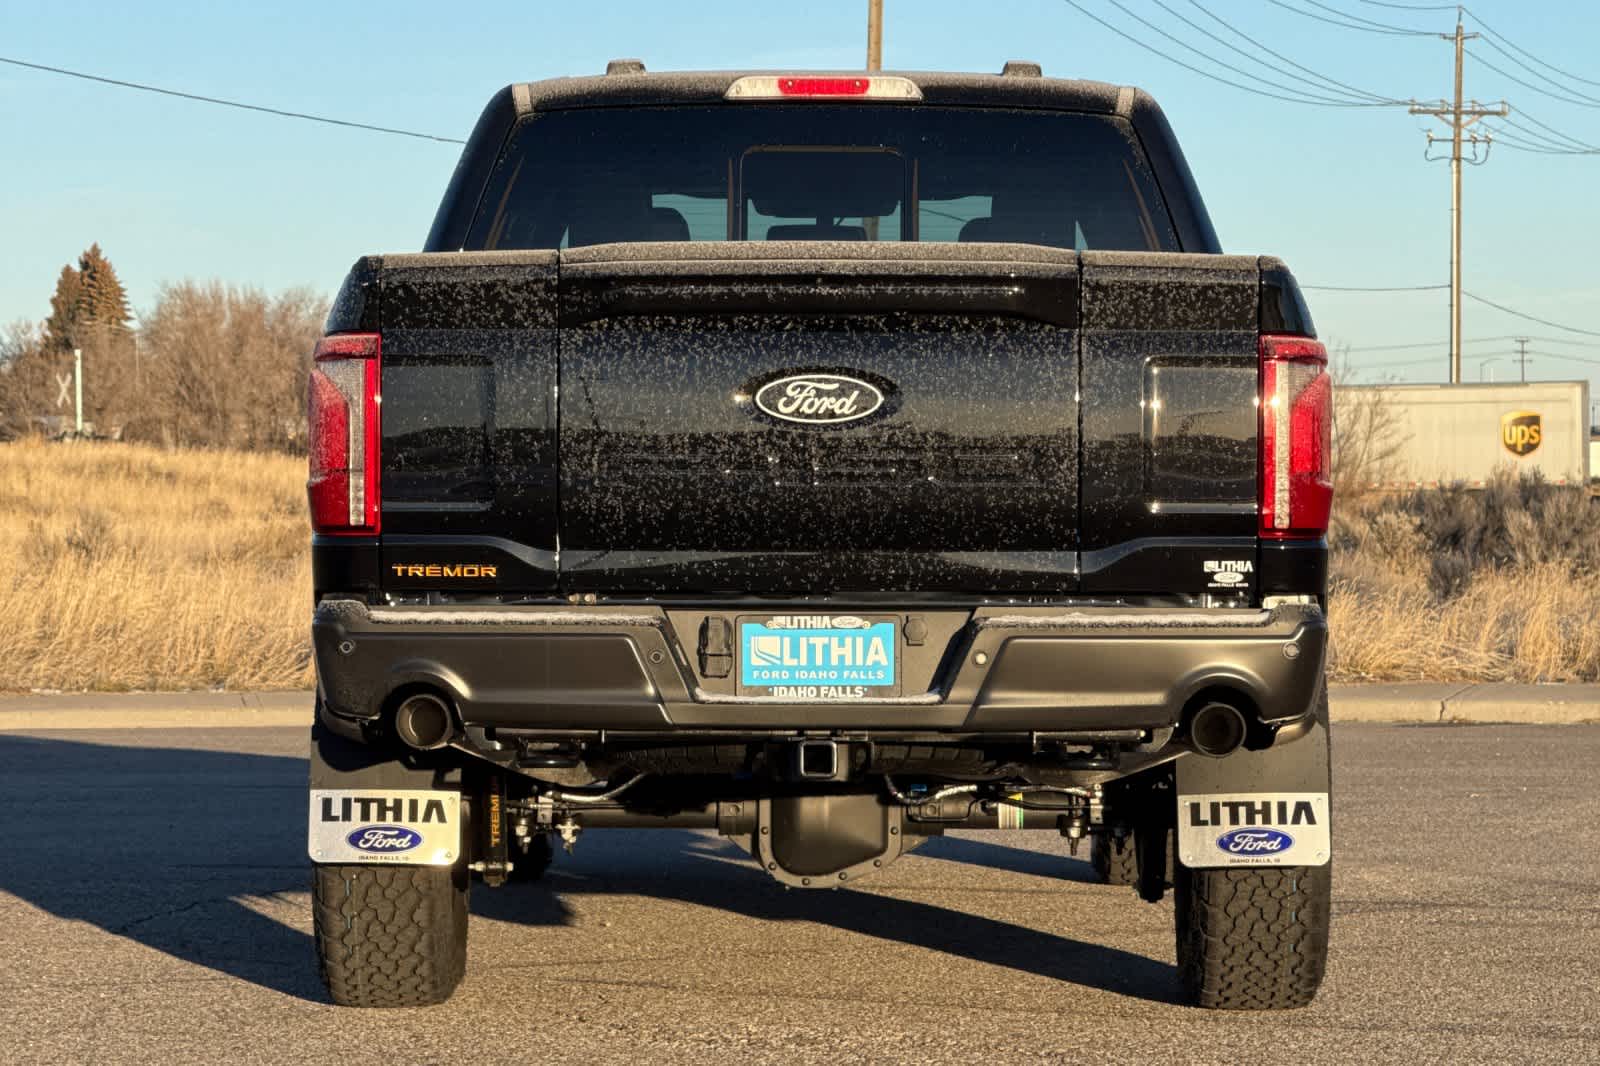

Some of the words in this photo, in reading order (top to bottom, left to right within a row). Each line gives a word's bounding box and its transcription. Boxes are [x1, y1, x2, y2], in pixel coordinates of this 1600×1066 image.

[778, 381, 859, 414] Ford
[1504, 425, 1541, 451] ups
[391, 565, 497, 577] TREMOR
[785, 615, 832, 629] LITHIA
[782, 636, 889, 666] LITHIA
[752, 670, 790, 680] FORD
[795, 670, 838, 680] IDAHO
[843, 670, 885, 680] FALLS
[774, 686, 817, 697] IDAHO
[820, 686, 864, 697] FALLS
[321, 797, 447, 823] LITHIA
[1190, 801, 1317, 826] LITHIA
[358, 829, 412, 849] Ford
[1229, 832, 1282, 852] Ford
